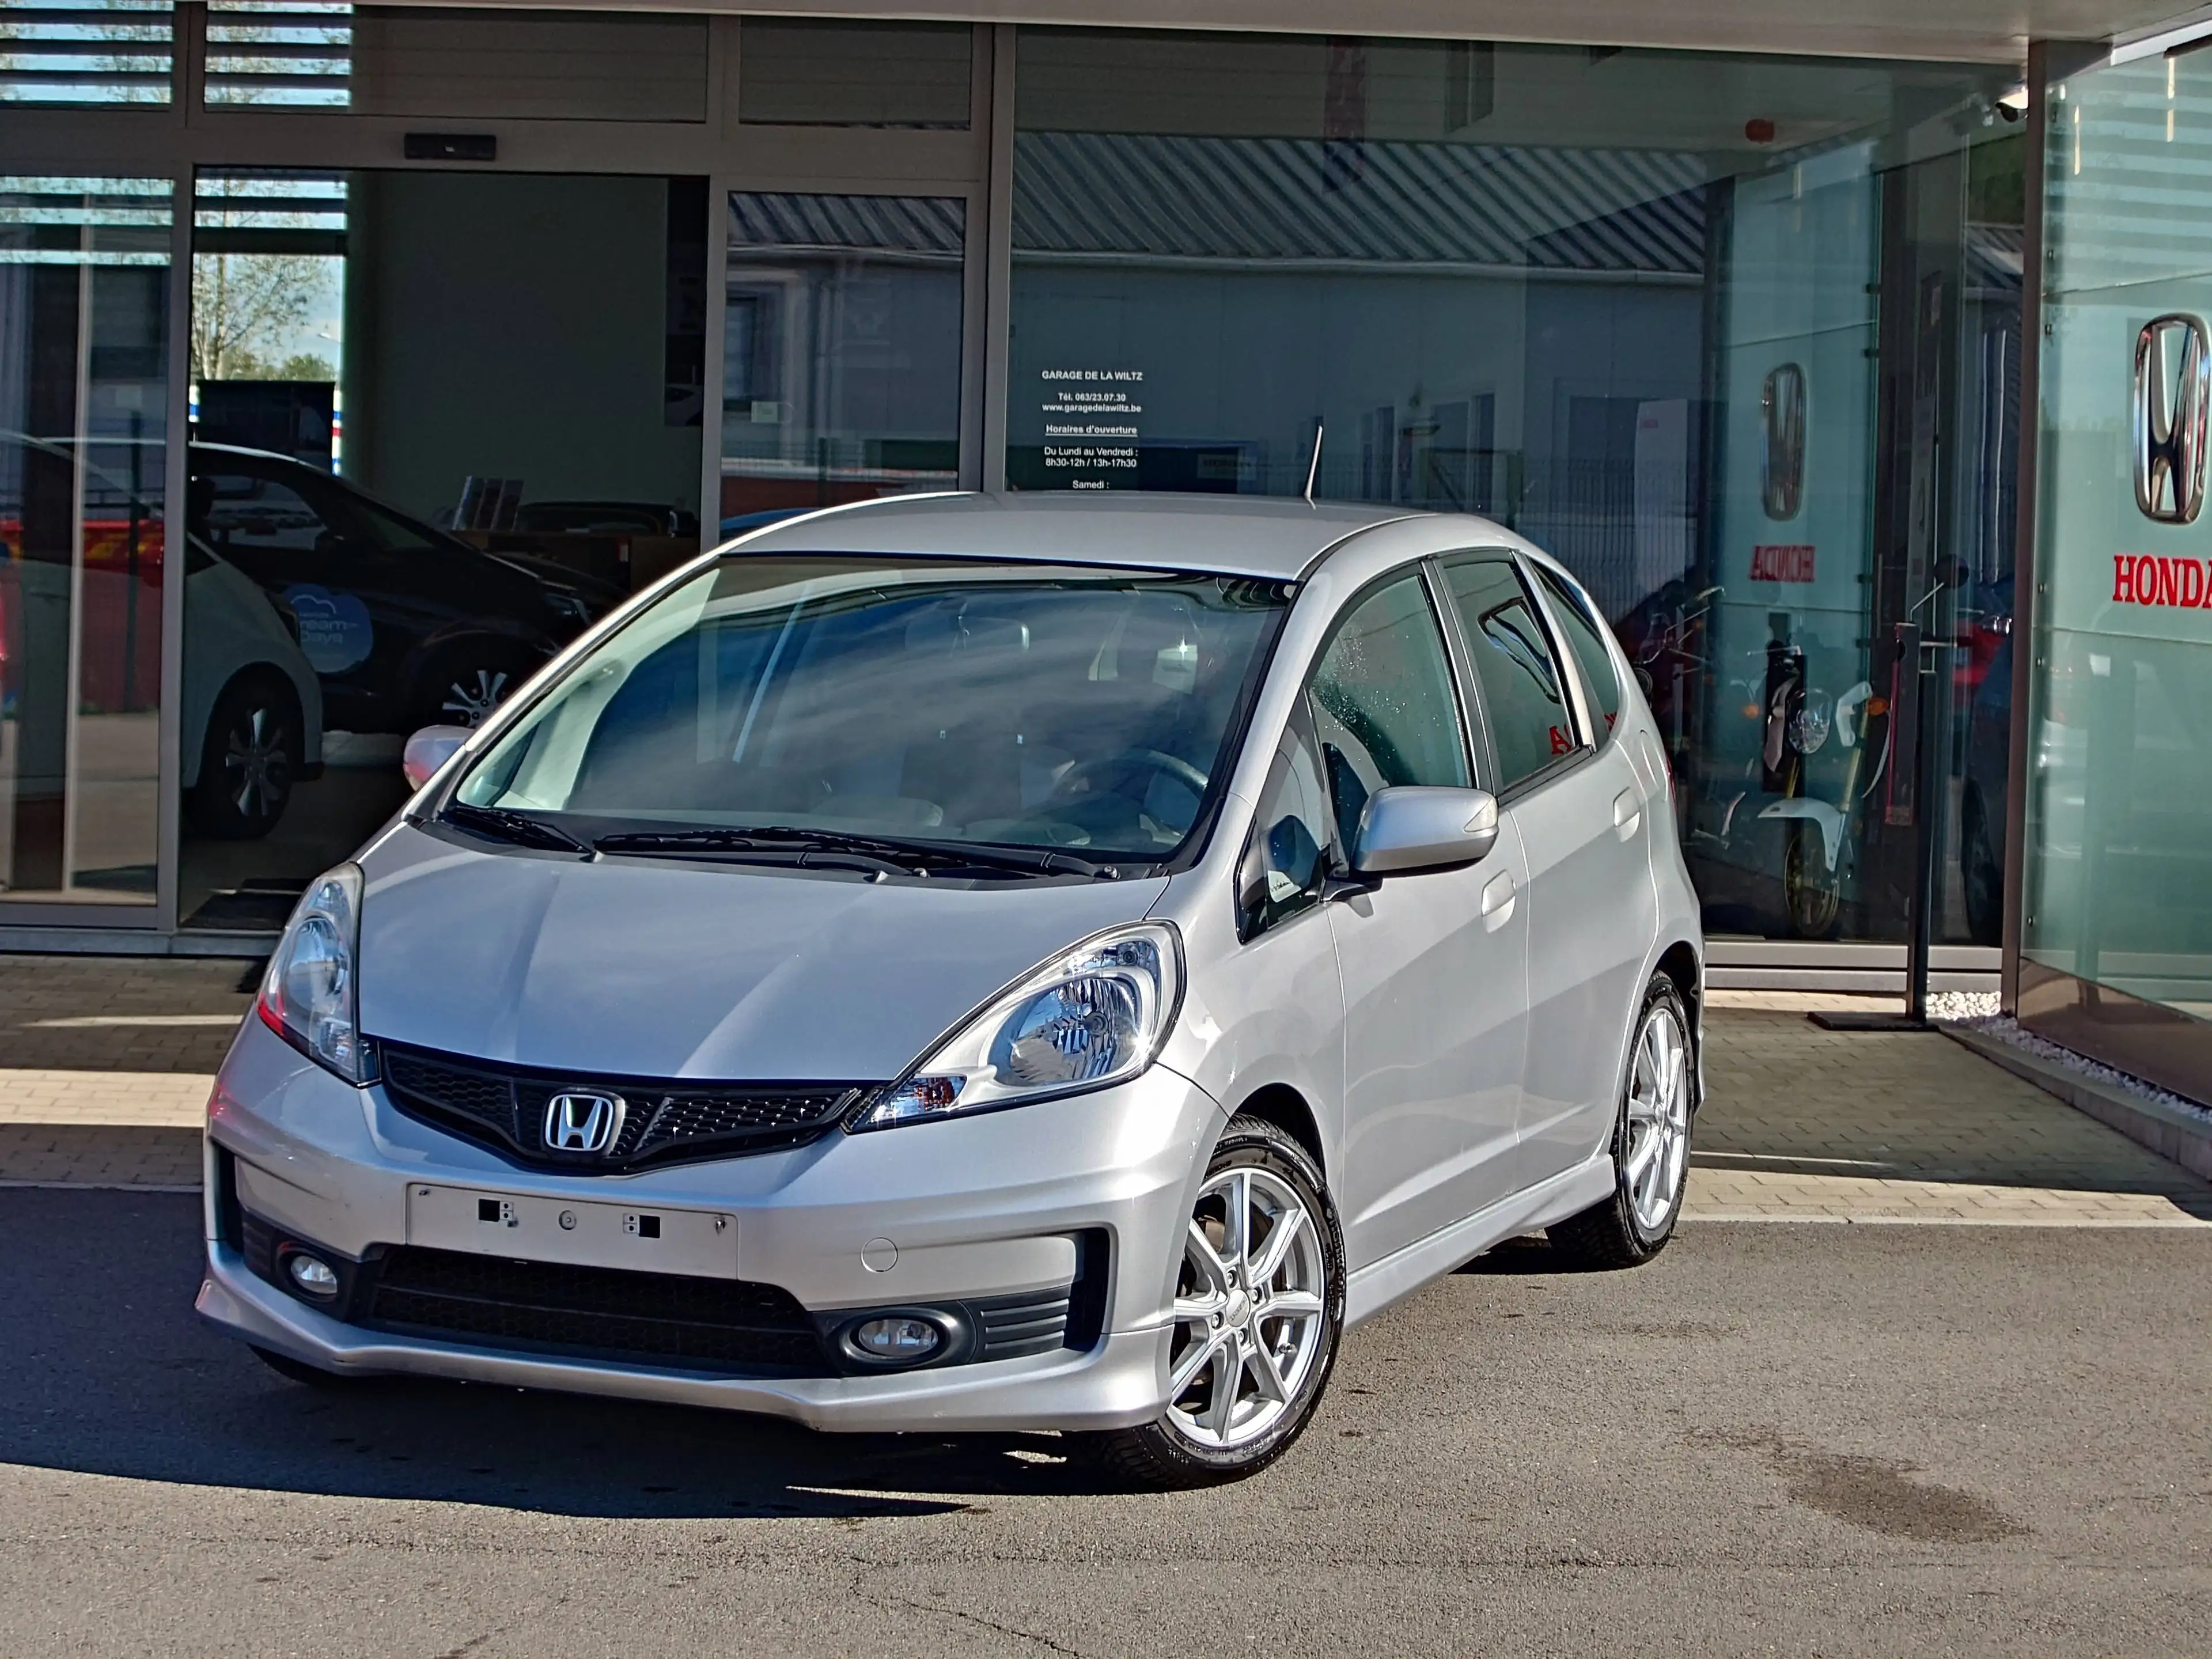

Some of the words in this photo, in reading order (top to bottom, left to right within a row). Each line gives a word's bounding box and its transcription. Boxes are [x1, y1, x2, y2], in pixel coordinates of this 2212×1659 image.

[1041, 370, 1082, 380] GARAGE
[1085, 371, 1098, 380] DE
[1100, 371, 1113, 381] LA
[1114, 372, 1143, 381] WILTZ
[1058, 392, 1073, 402] Tél.
[1075, 393, 1126, 402] 063/23.07.30
[1042, 404, 1141, 413] www.garagedelawiltz.be
[1046, 424, 1084, 434] Horaires
[1086, 425, 1138, 434] d'ouverture
[1044, 446, 1056, 456] Du
[1058, 446, 1082, 456] Lundi
[1096, 447, 1133, 457] Vendredi
[1046, 457, 1085, 467] 8h30-12h
[1093, 458, 1137, 468] 13h-17h30
[1072, 479, 1104, 489] Samedi
[300, 620, 348, 630] ream
